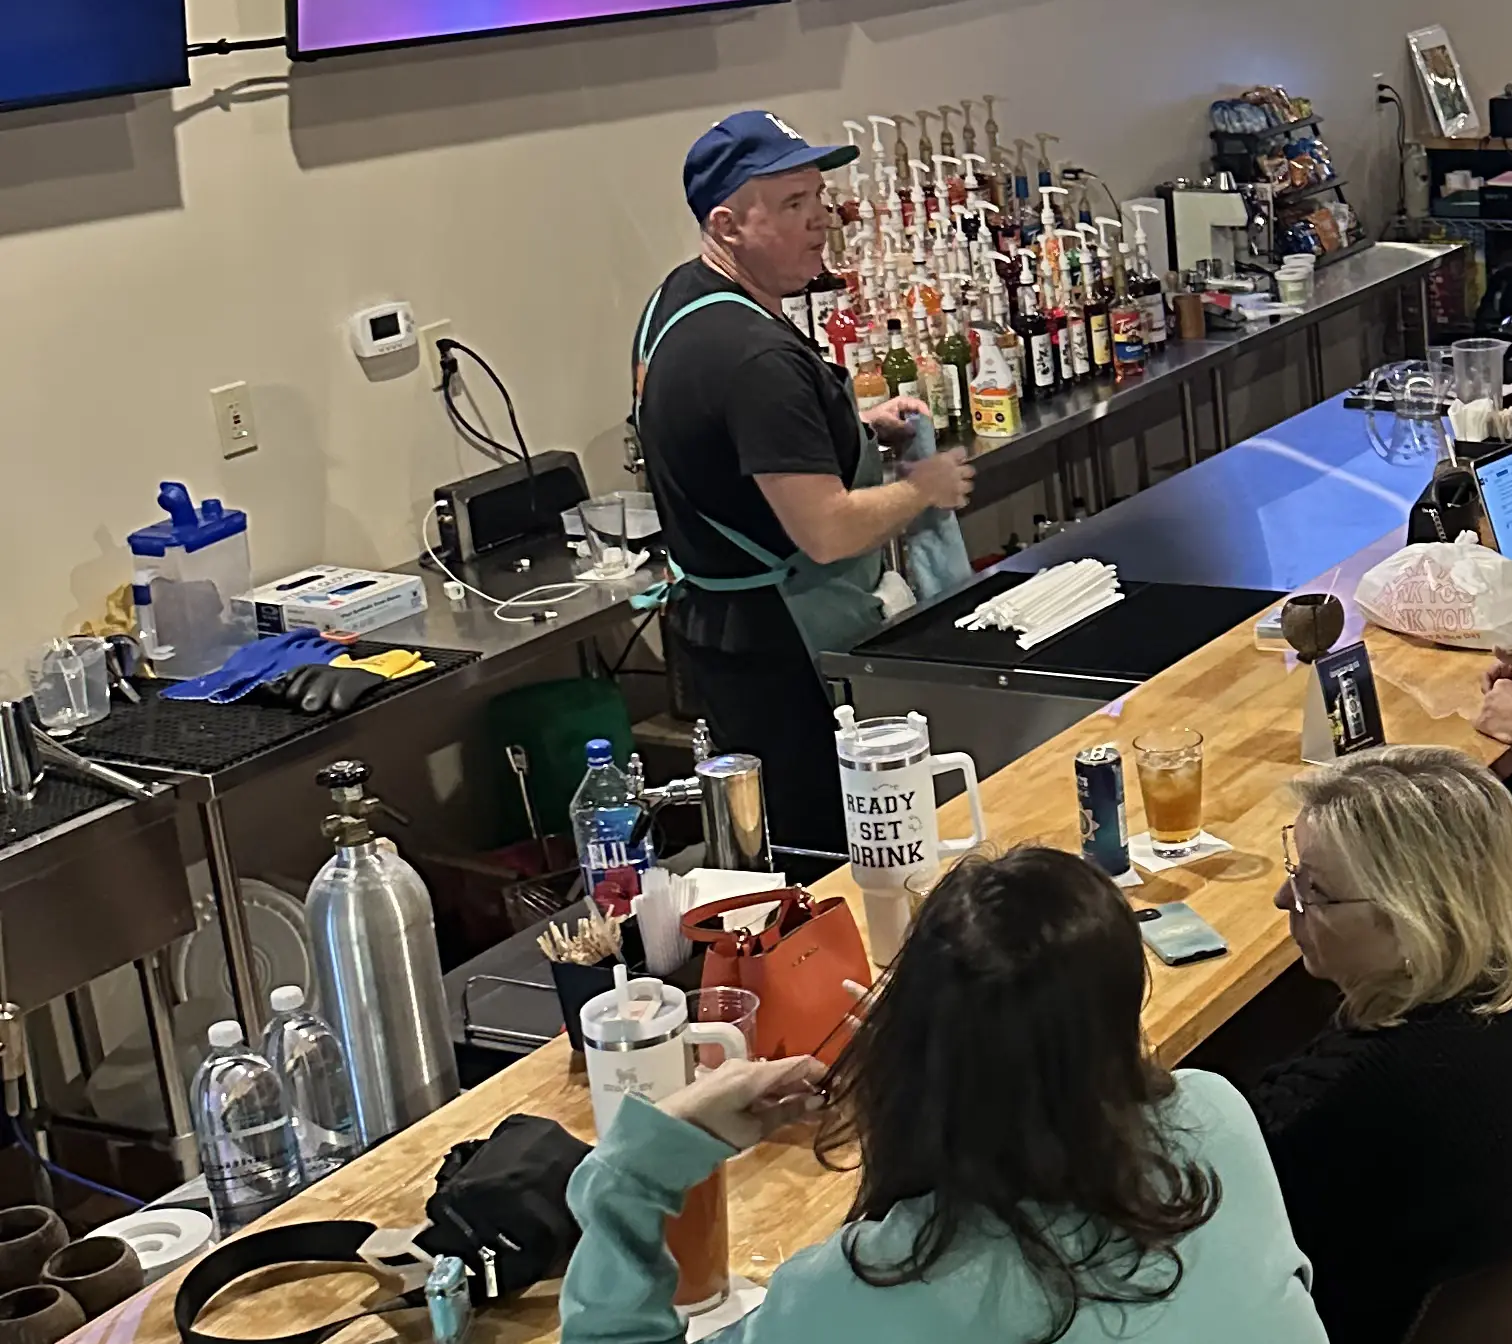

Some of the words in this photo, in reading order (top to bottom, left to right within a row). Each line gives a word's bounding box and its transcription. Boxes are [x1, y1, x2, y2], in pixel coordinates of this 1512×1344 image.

[1426, 608, 1475, 633] YOU
[846, 790, 916, 815] READY
[860, 820, 903, 841] SET
[850, 840, 925, 869] DRINK
